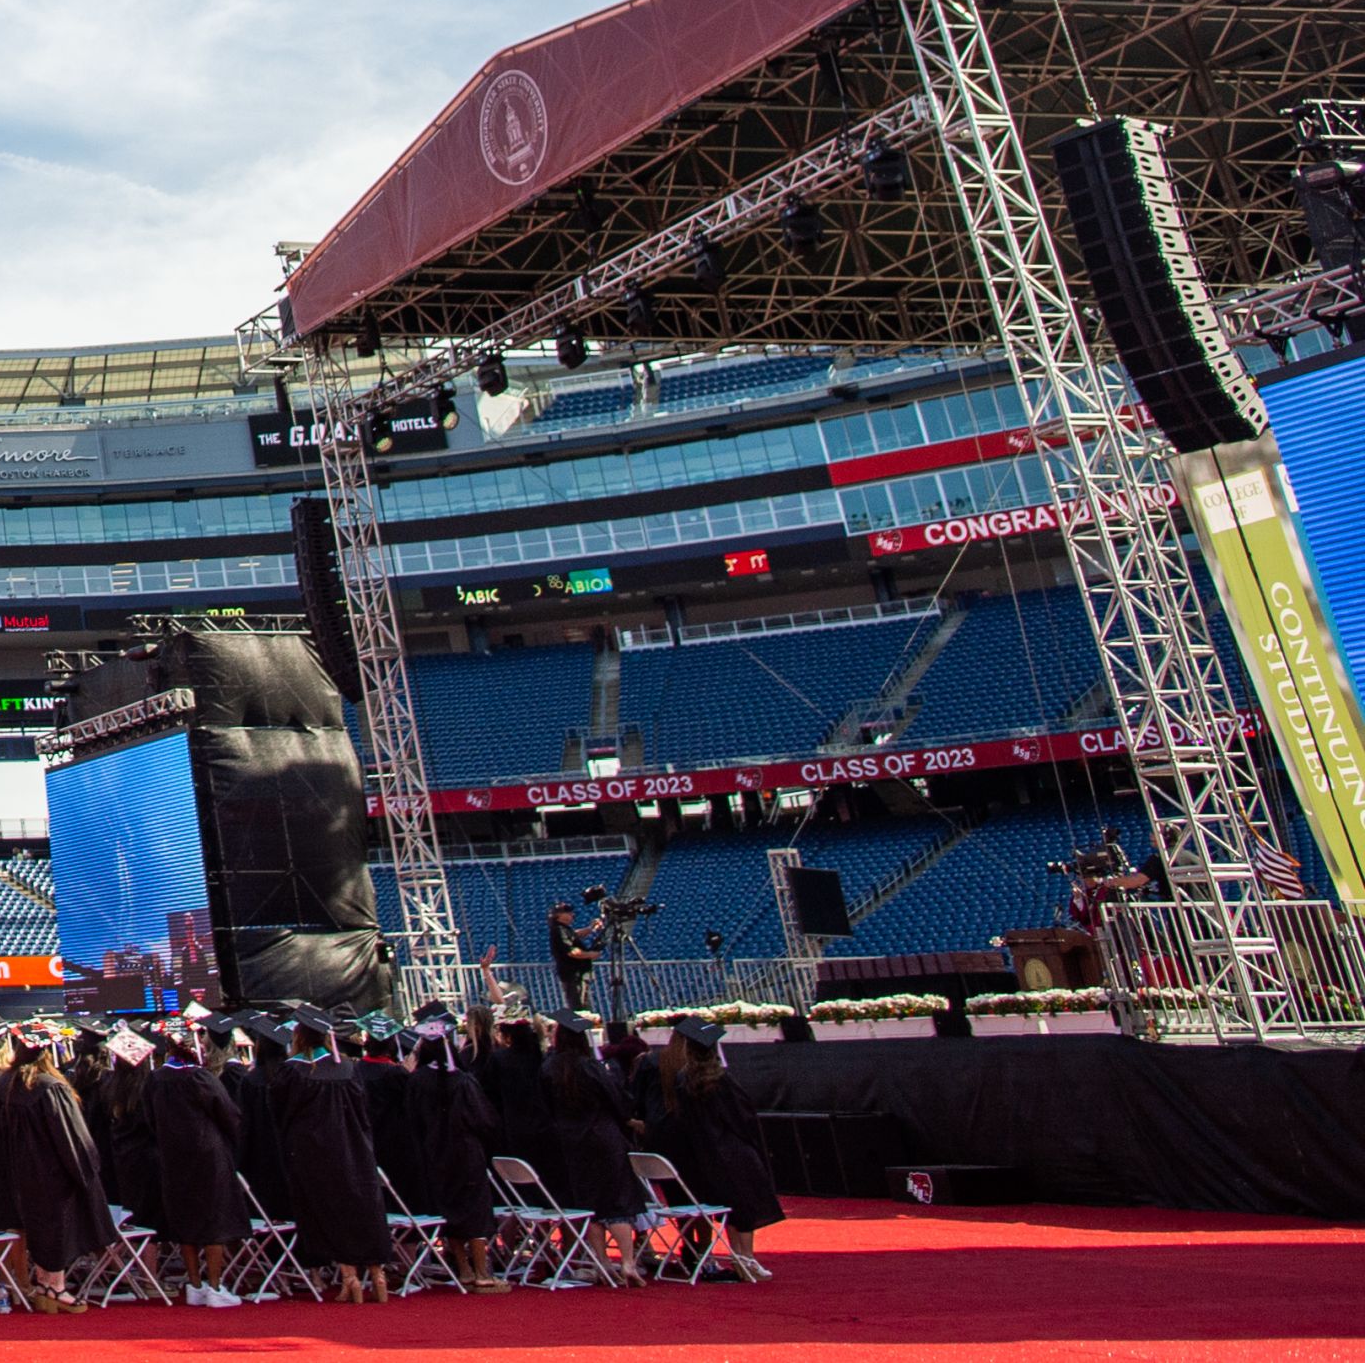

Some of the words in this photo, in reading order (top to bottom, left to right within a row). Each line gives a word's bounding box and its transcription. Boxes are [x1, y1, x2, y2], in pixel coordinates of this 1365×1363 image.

[257, 433, 281, 446] THE
[391, 417, 437, 433] HOTELS
[113, 446, 187, 459] TERRACE
[45, 469, 91, 478] HARBOR
[1203, 480, 1265, 509] COLLEGE
[4, 614, 49, 627] Mutual
[1259, 633, 1336, 795] STUDIES
[1080, 725, 1161, 754] CLASS
[801, 758, 879, 782] CLASS
[883, 754, 915, 775] OF
[923, 748, 975, 771] 2023
[527, 782, 602, 805] CLASS
[607, 779, 637, 799] OF
[645, 776, 693, 797] 2023
